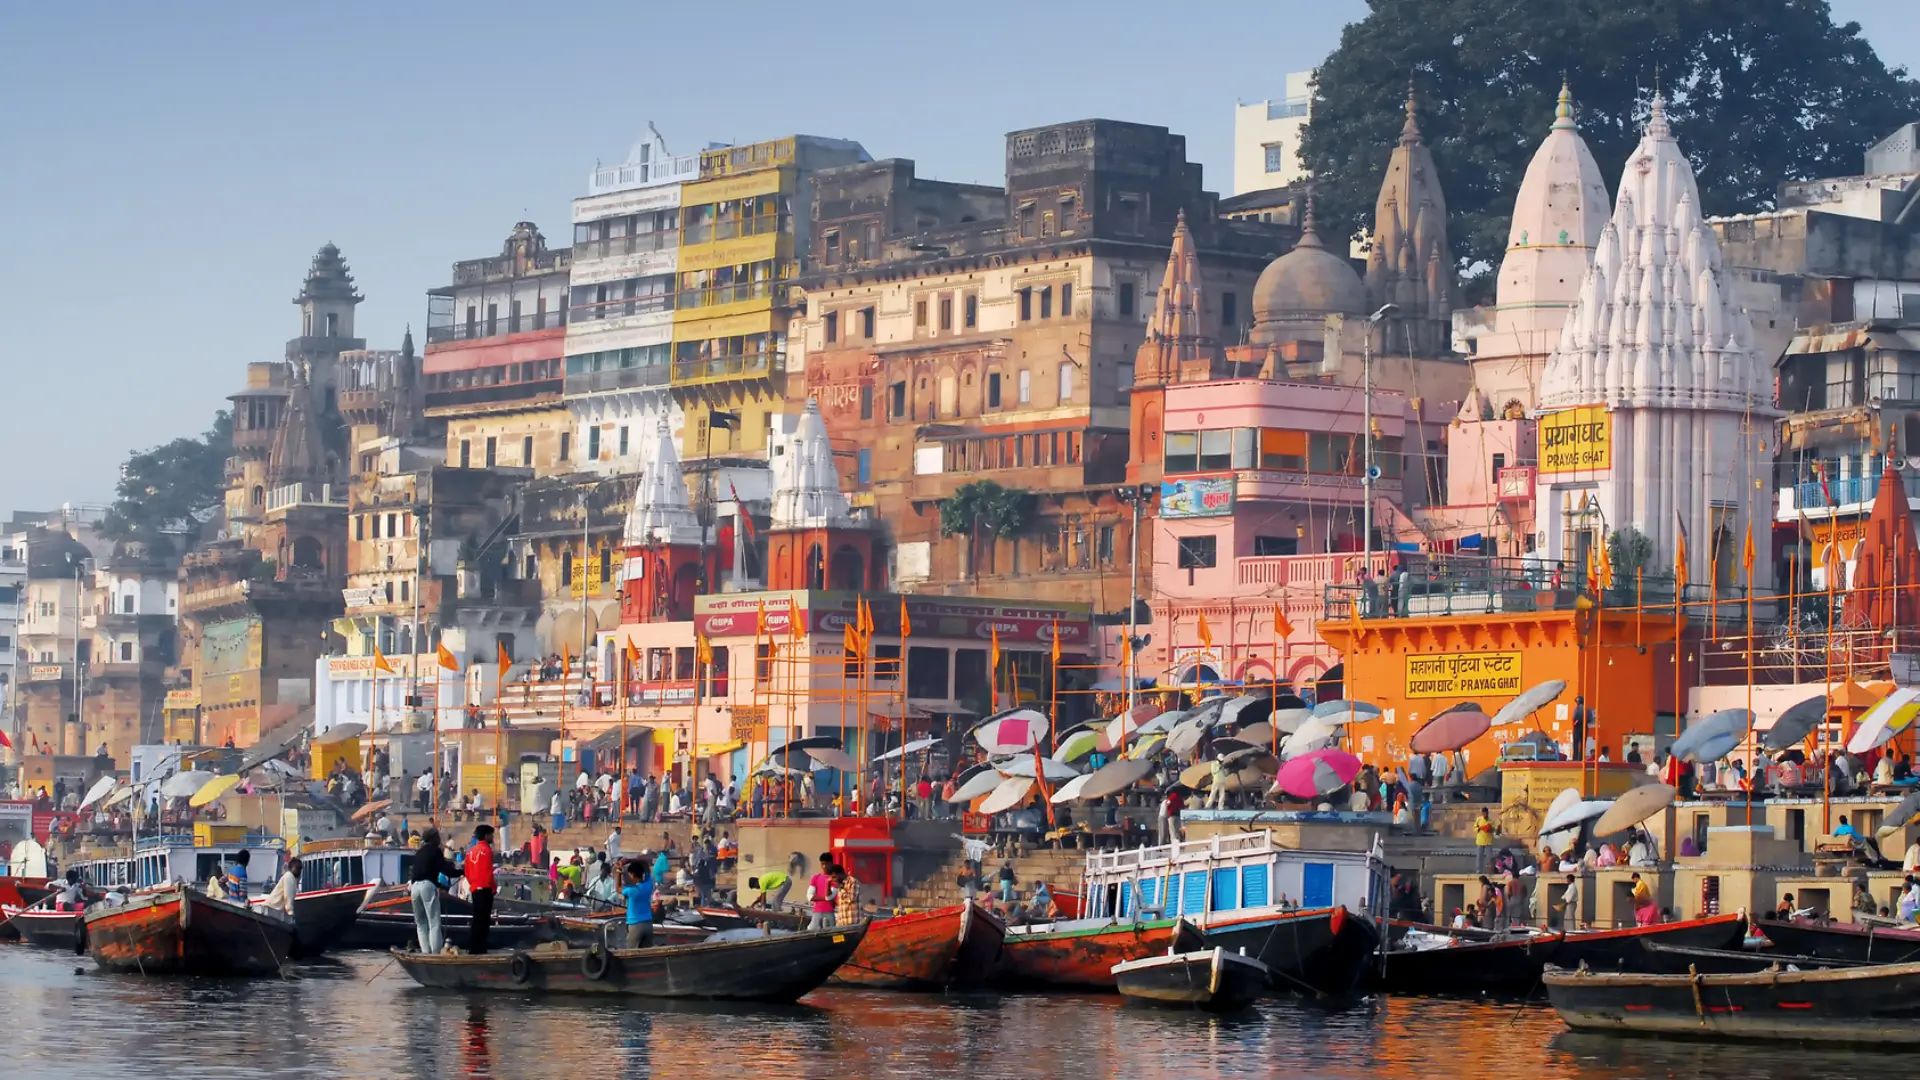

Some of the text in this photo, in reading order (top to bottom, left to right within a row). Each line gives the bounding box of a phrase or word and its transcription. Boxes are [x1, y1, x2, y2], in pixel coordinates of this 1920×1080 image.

[1544, 422, 1604, 450] प्रयाग घाट
[1547, 450, 1604, 467] PRAYAG GHAT
[711, 615, 789, 626] RUPA RUPA
[830, 615, 858, 625] RUP
[1410, 656, 1446, 675] महारानी
[1409, 680, 1453, 693] प्रयाग घाट
[1460, 677, 1519, 691] PRAYAG GHAT
